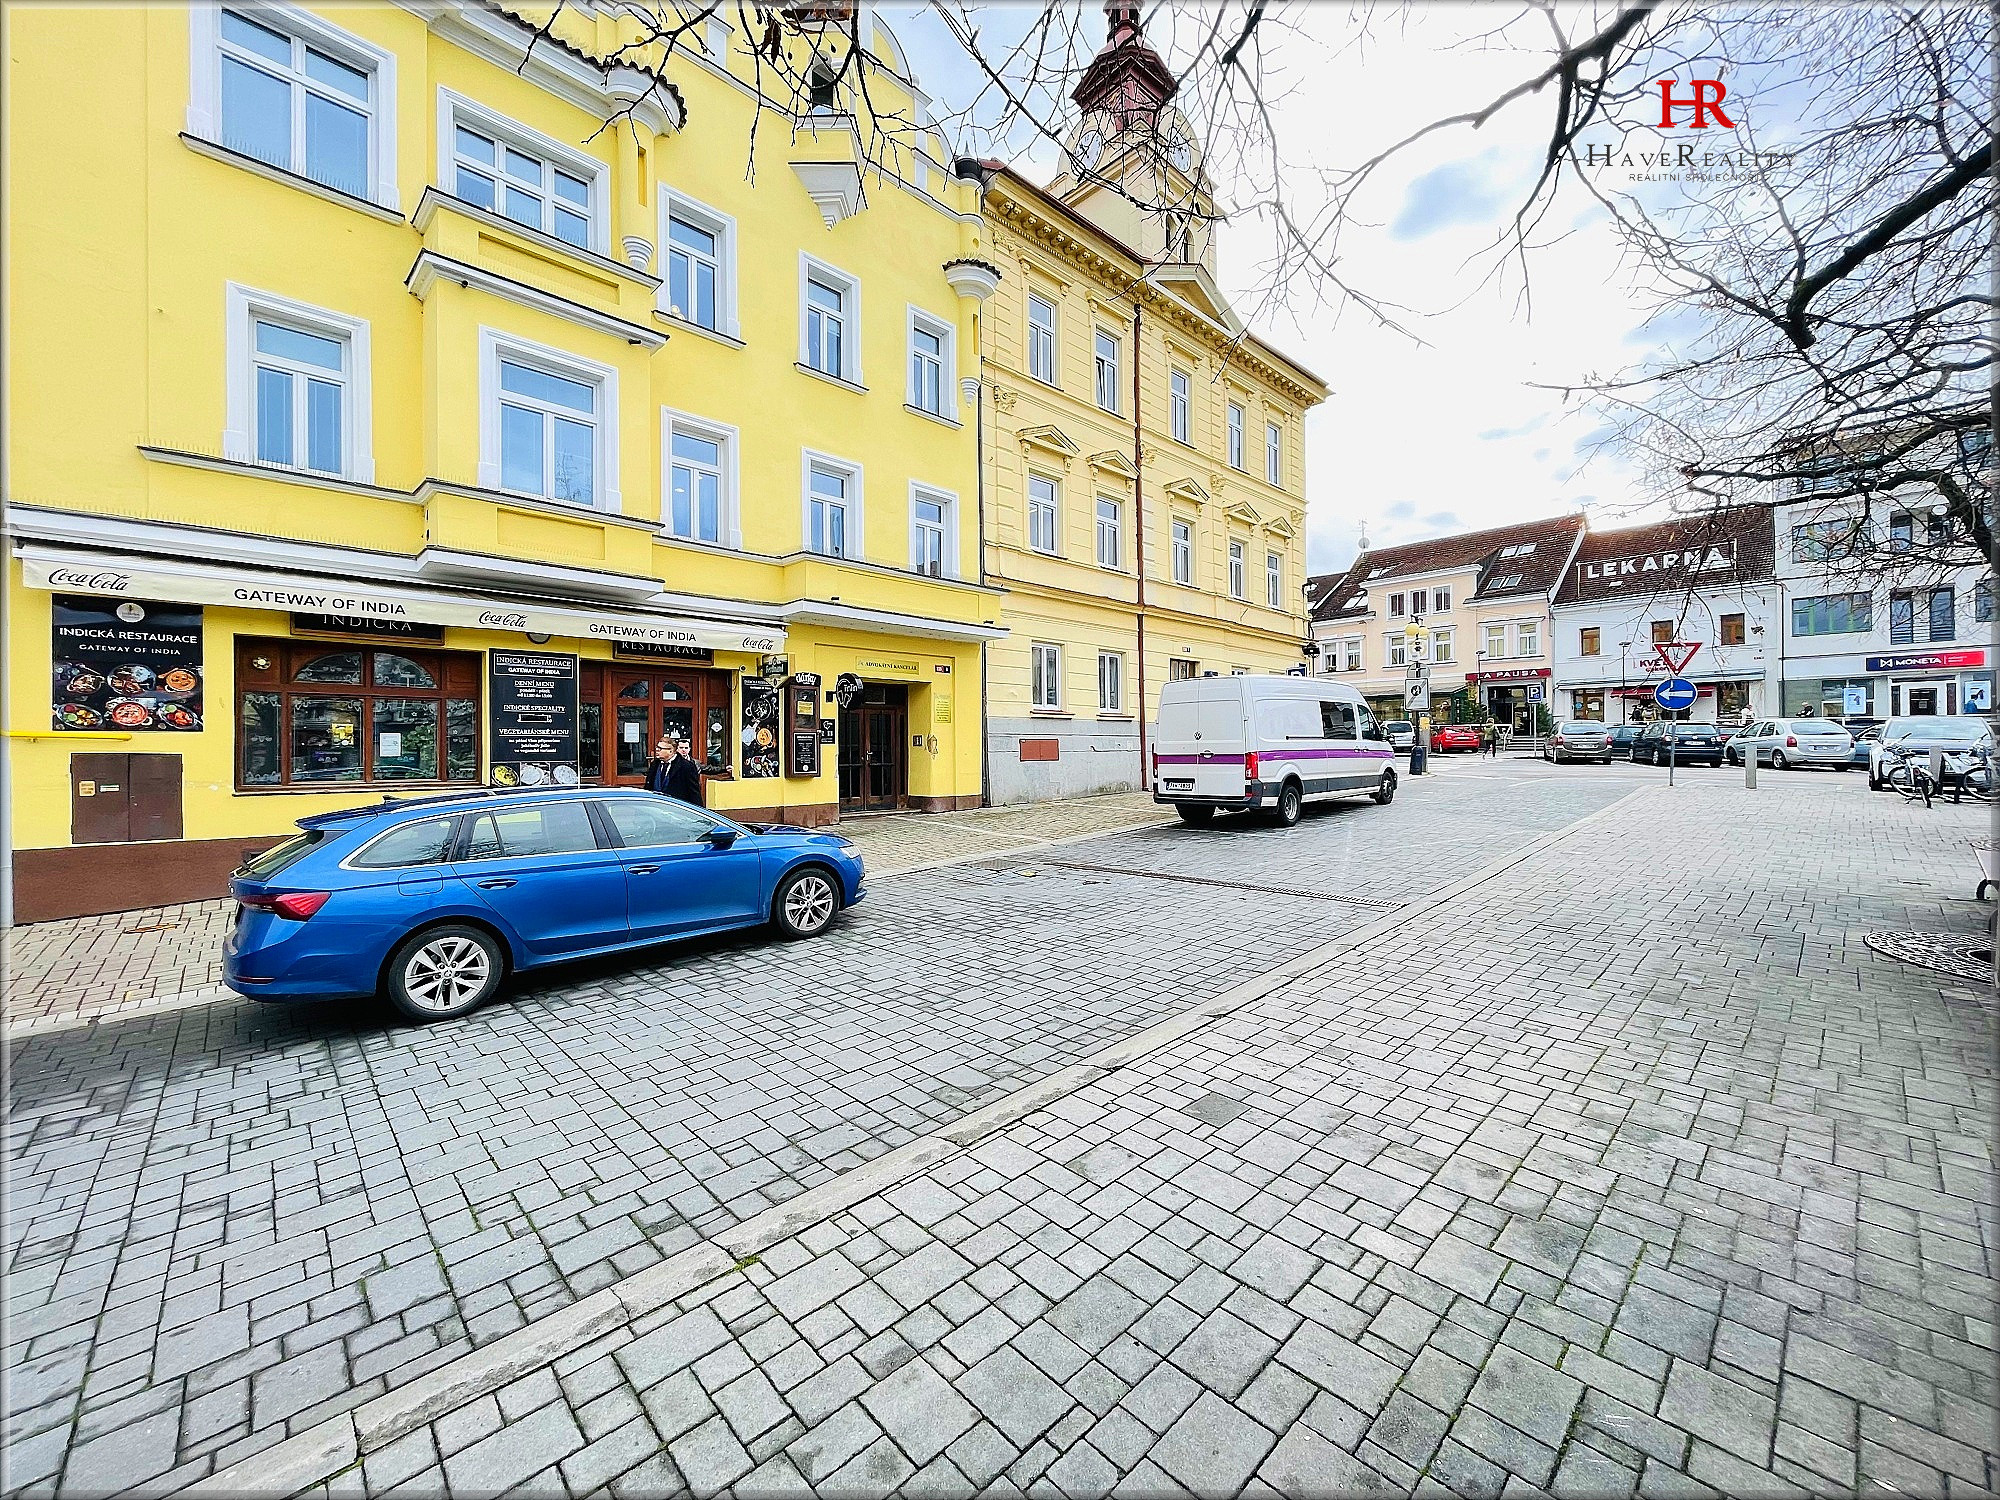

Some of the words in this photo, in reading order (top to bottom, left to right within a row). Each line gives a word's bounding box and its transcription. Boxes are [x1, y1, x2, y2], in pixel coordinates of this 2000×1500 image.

[234, 588, 327, 608] GATEWAY
[332, 598, 356, 610] OF
[361, 601, 406, 615] INDIA
[59, 627, 115, 640] INDICKÁ
[118, 630, 198, 644] RESTAURACE
[589, 623, 647, 638] GATEWAY
[649, 629, 665, 639] OF
[667, 631, 697, 642] INDIA
[78, 643, 131, 653] GATEWAY
[496, 656, 527, 665] INDICKÁ
[528, 658, 572, 667] RESTAURACE
[1895, 657, 1942, 666] MONETA
[1530, 687, 1539, 698] P
